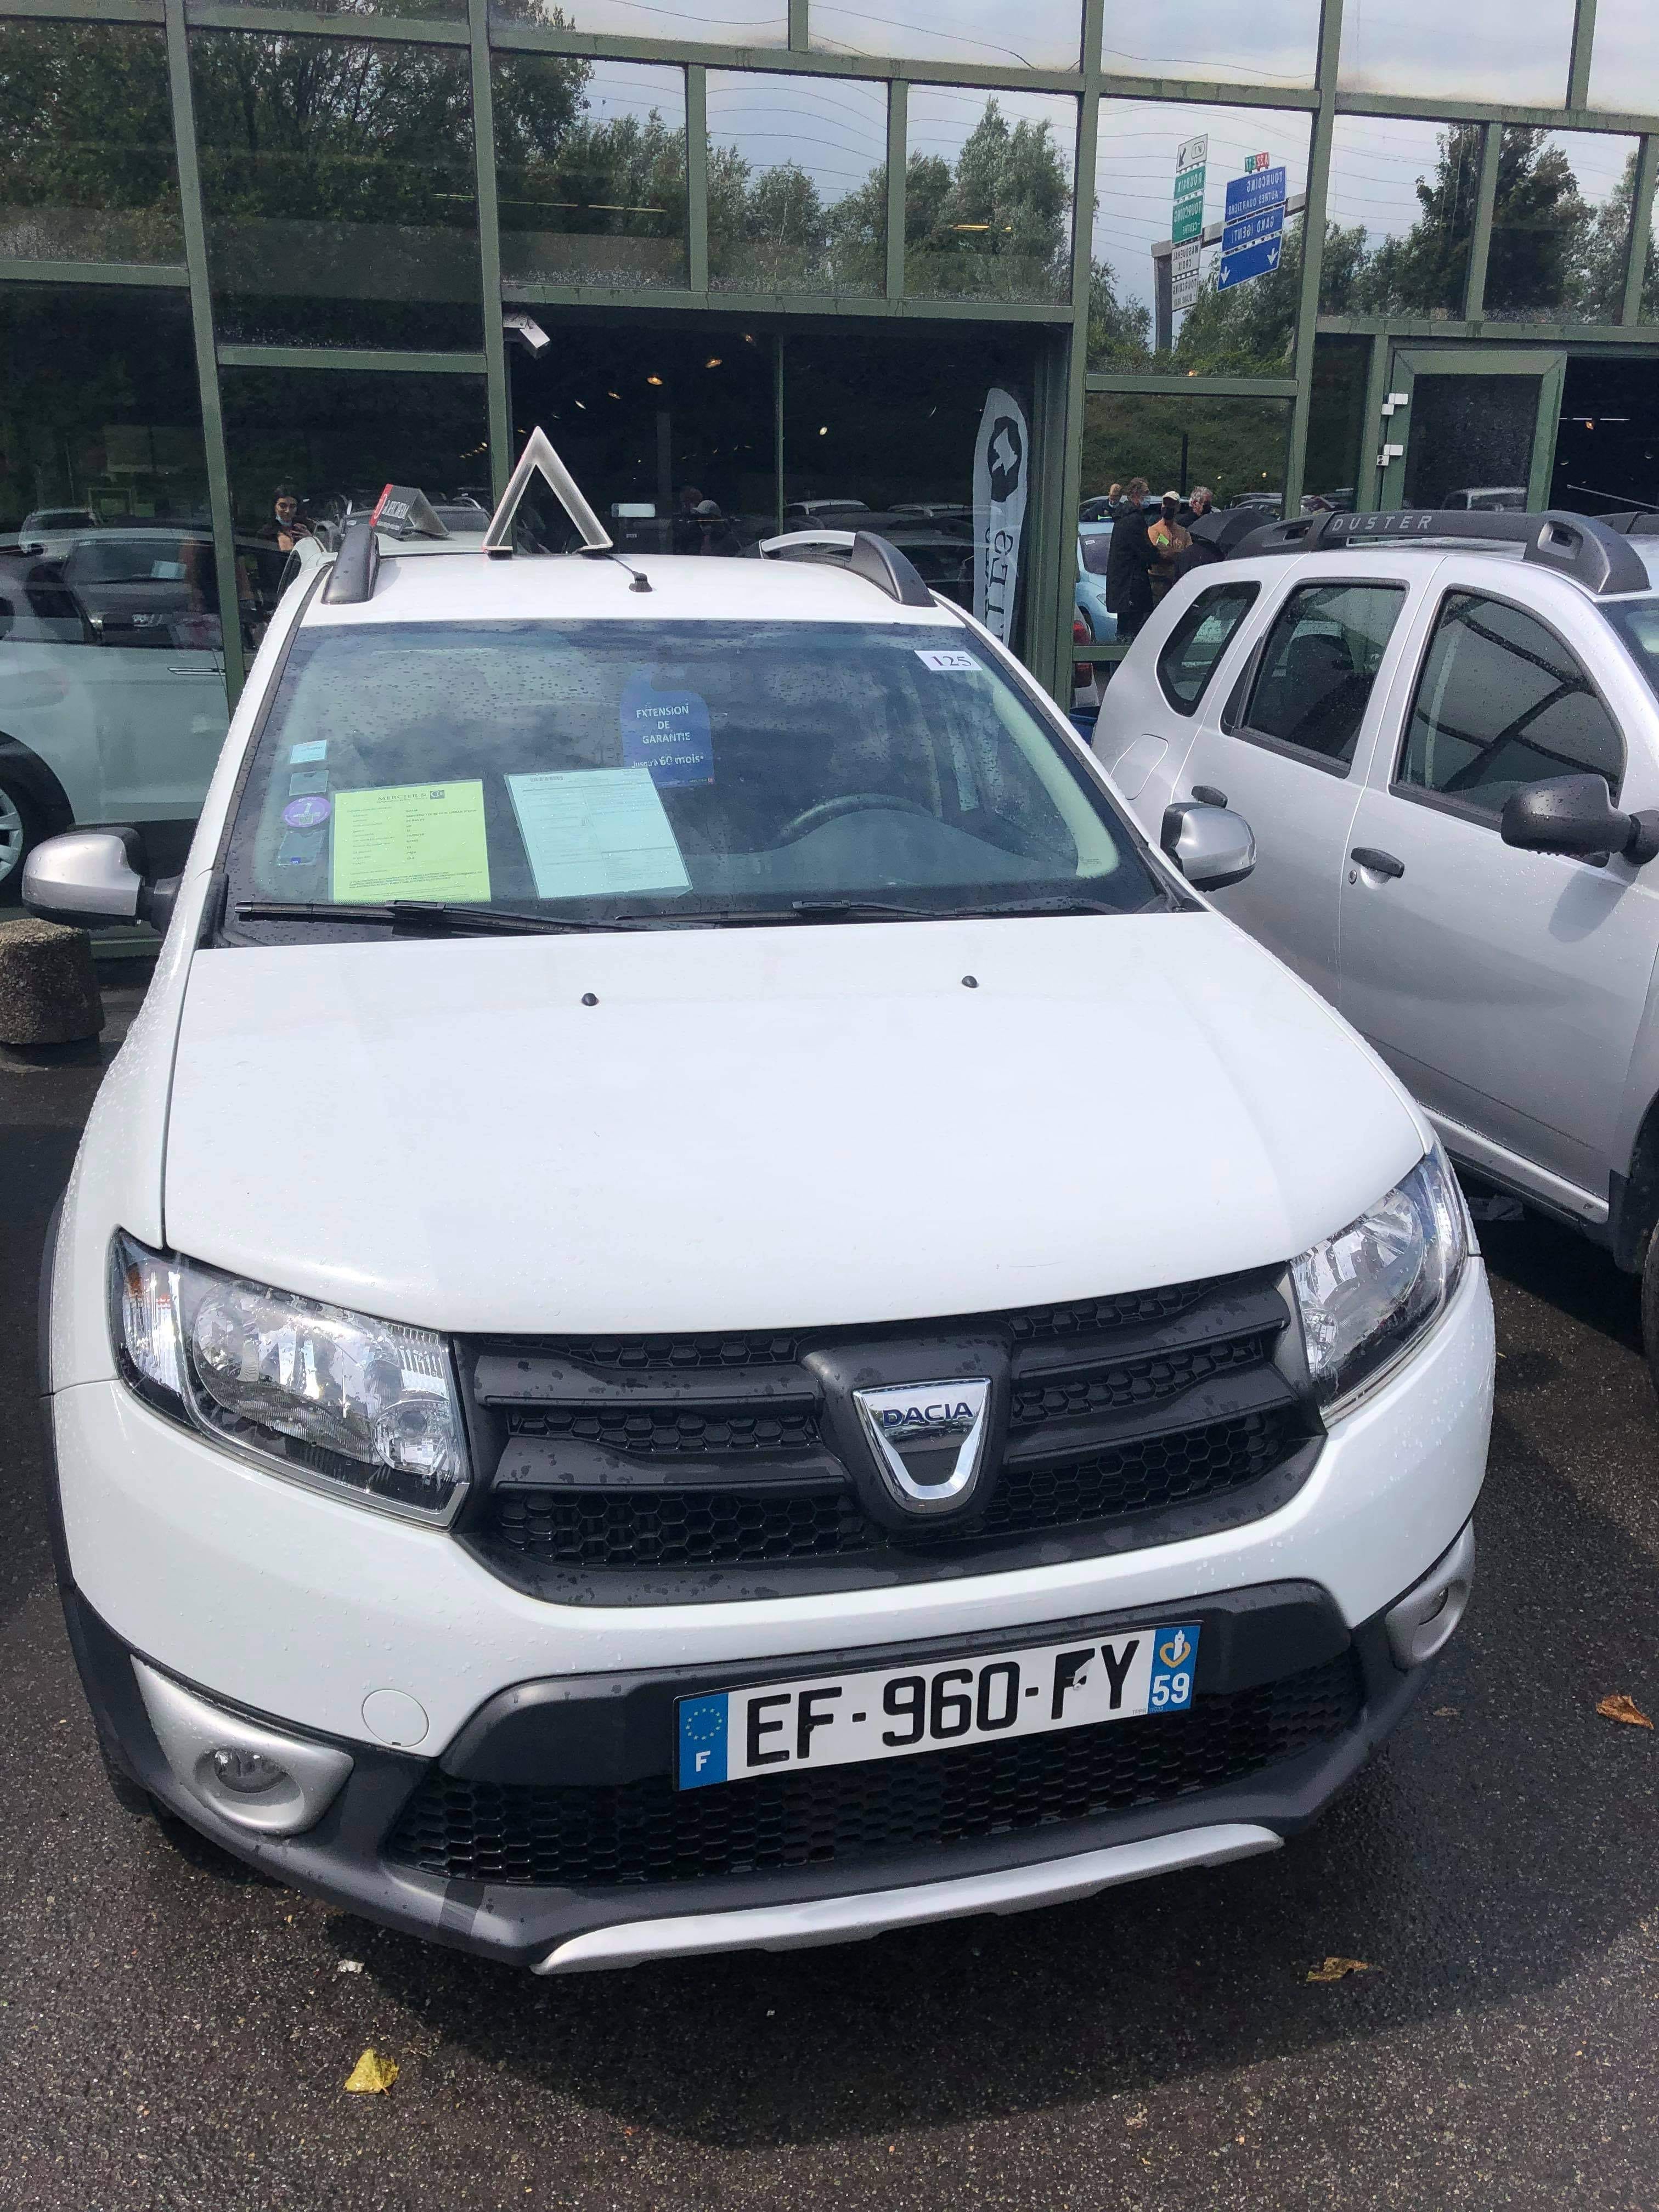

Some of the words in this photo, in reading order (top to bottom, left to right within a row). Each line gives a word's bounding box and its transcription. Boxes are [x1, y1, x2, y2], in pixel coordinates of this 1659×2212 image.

[1332, 515, 1433, 531] DUSTER
[930, 654, 972, 667] 125
[636, 706, 690, 718] EXTENSION
[658, 720, 670, 730] DE
[642, 732, 691, 744] GARANTIE
[659, 755, 674, 766] 60
[882, 1402, 974, 1427] DACIA
[695, 1750, 711, 1772] F
[1151, 1672, 1190, 1706] 59
